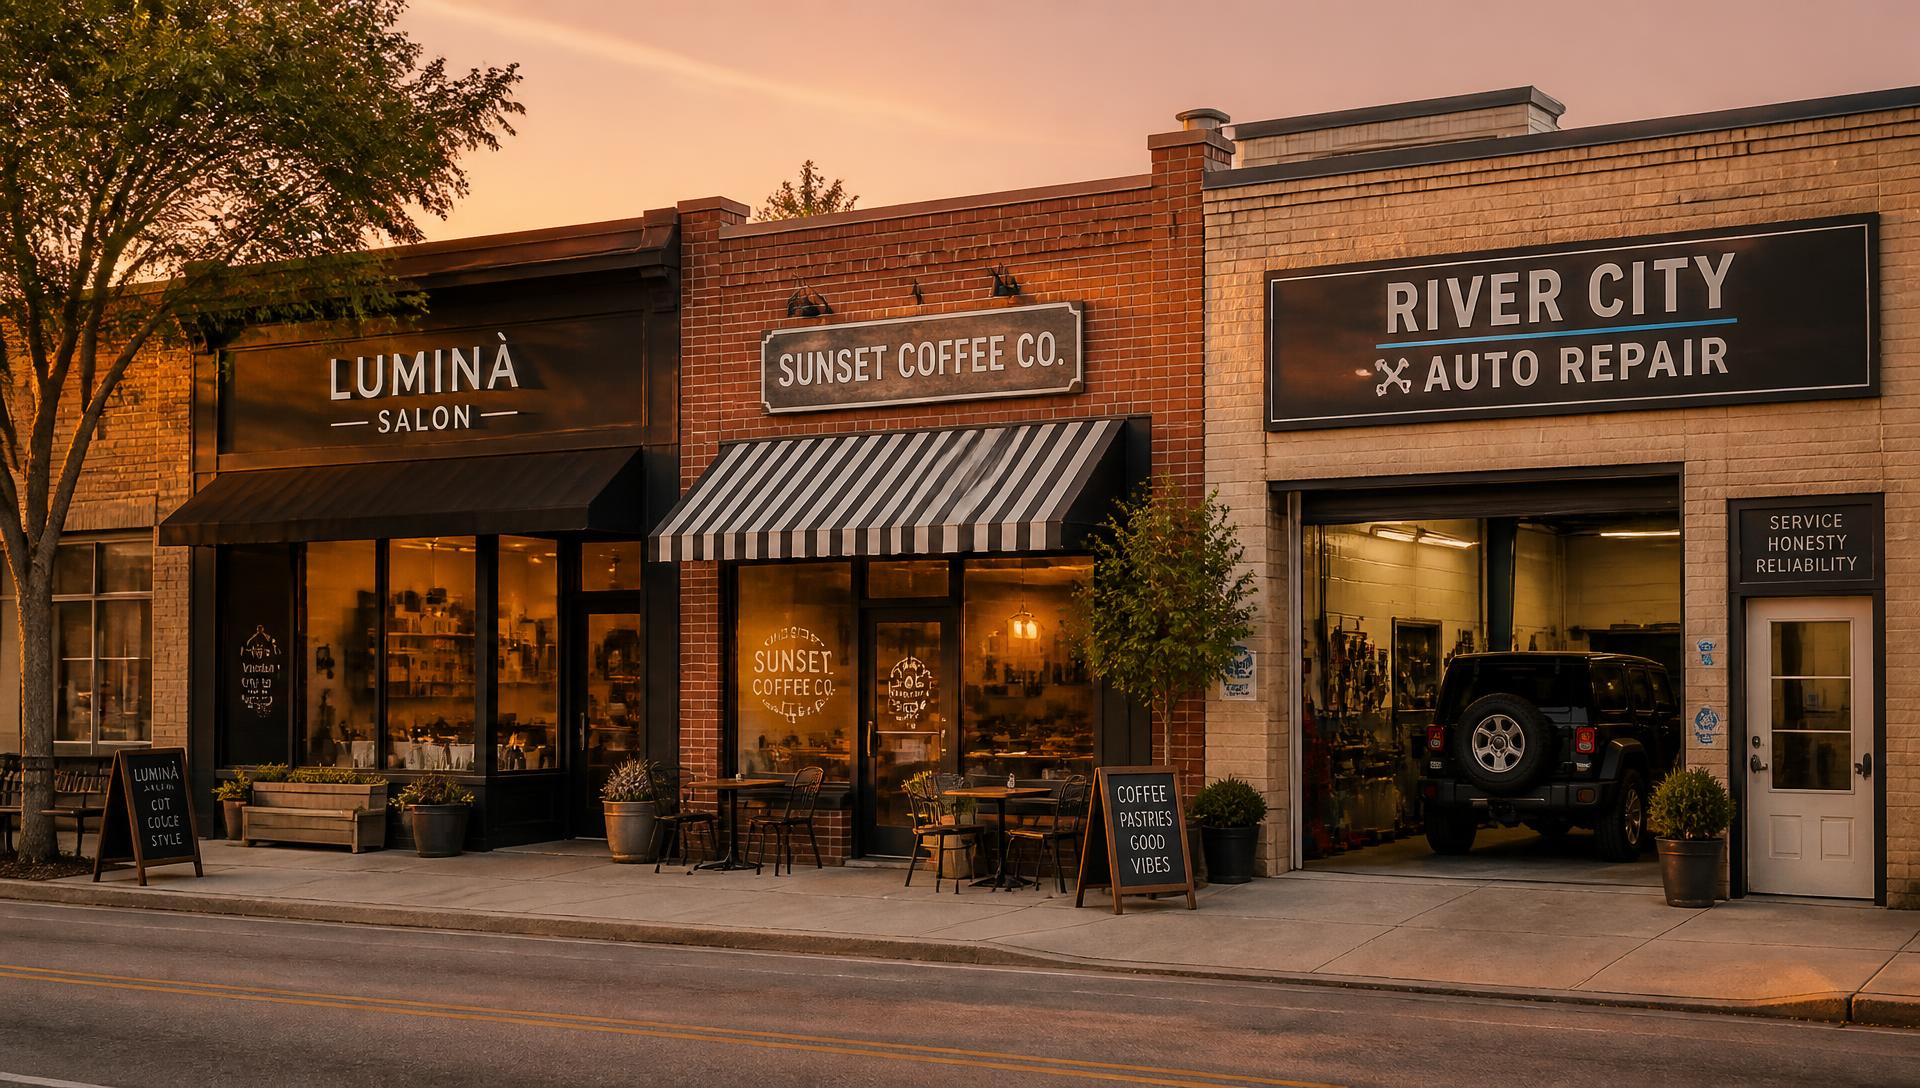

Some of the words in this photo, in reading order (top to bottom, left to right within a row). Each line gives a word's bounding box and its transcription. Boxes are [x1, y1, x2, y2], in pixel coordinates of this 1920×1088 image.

[1387, 269, 1563, 334] RIVER
[1588, 253, 1735, 318] CITY
[330, 331, 519, 400] LUMINÀ
[778, 345, 887, 387] SUNSET
[898, 335, 1005, 378] COFFEE
[1016, 331, 1065, 368] CO.
[1424, 349, 1540, 393] AUTO
[1560, 336, 1729, 384] REPAIR
[377, 404, 470, 434] SALON
[1770, 513, 1843, 530] SERVICE
[1768, 534, 1848, 552] HONESTY
[1756, 556, 1858, 573] RELIABILITY
[754, 649, 833, 674] SUNSET
[752, 678, 811, 696] COFFEE
[1117, 785, 1168, 804] COFFEE
[1120, 810, 1173, 828] PASTRIES
[151, 832, 183, 847] STYLE
[1130, 834, 1166, 851] GOOD
[1131, 856, 1171, 874] VIBES
